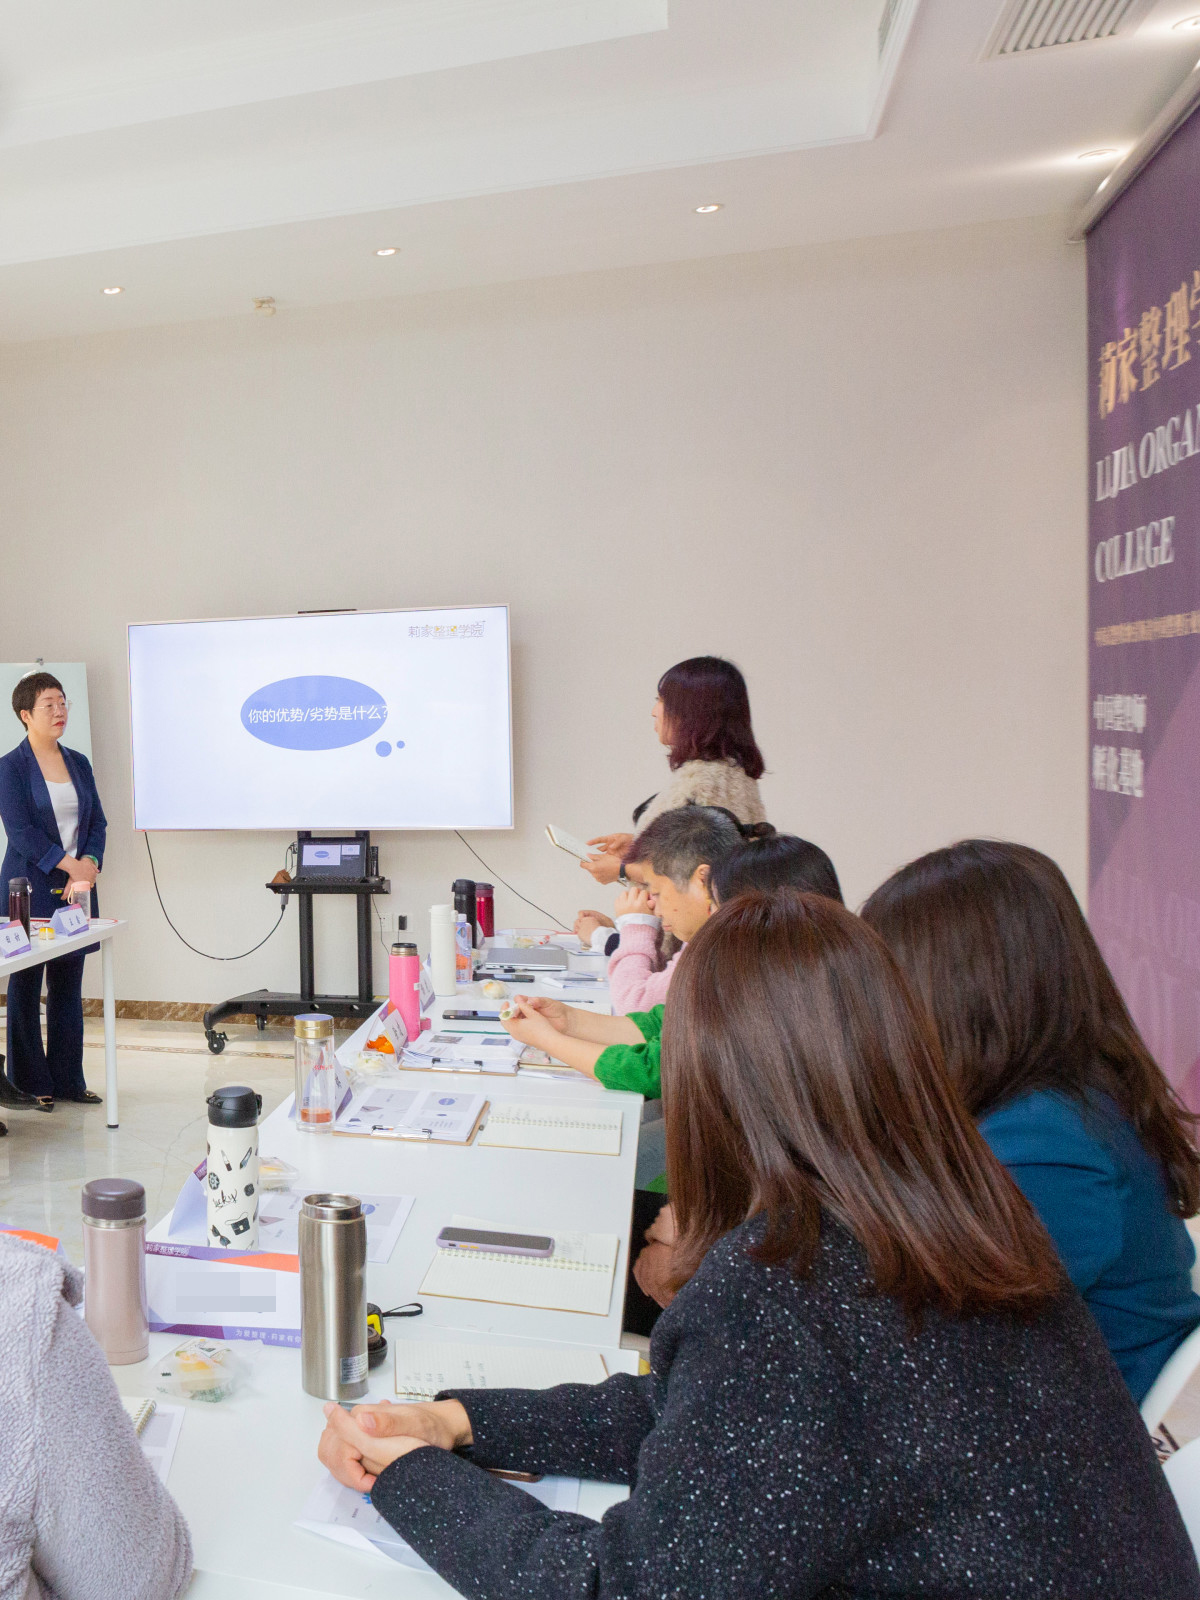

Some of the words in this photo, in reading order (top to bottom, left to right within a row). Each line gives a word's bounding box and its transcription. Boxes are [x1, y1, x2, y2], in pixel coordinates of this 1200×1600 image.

[1096, 441, 1138, 501] LIJIA
[1138, 402, 1200, 479] ORGA
[1094, 515, 1177, 583] COLLEGE
[247, 705, 388, 724] 你的优势/劣势是什么?
